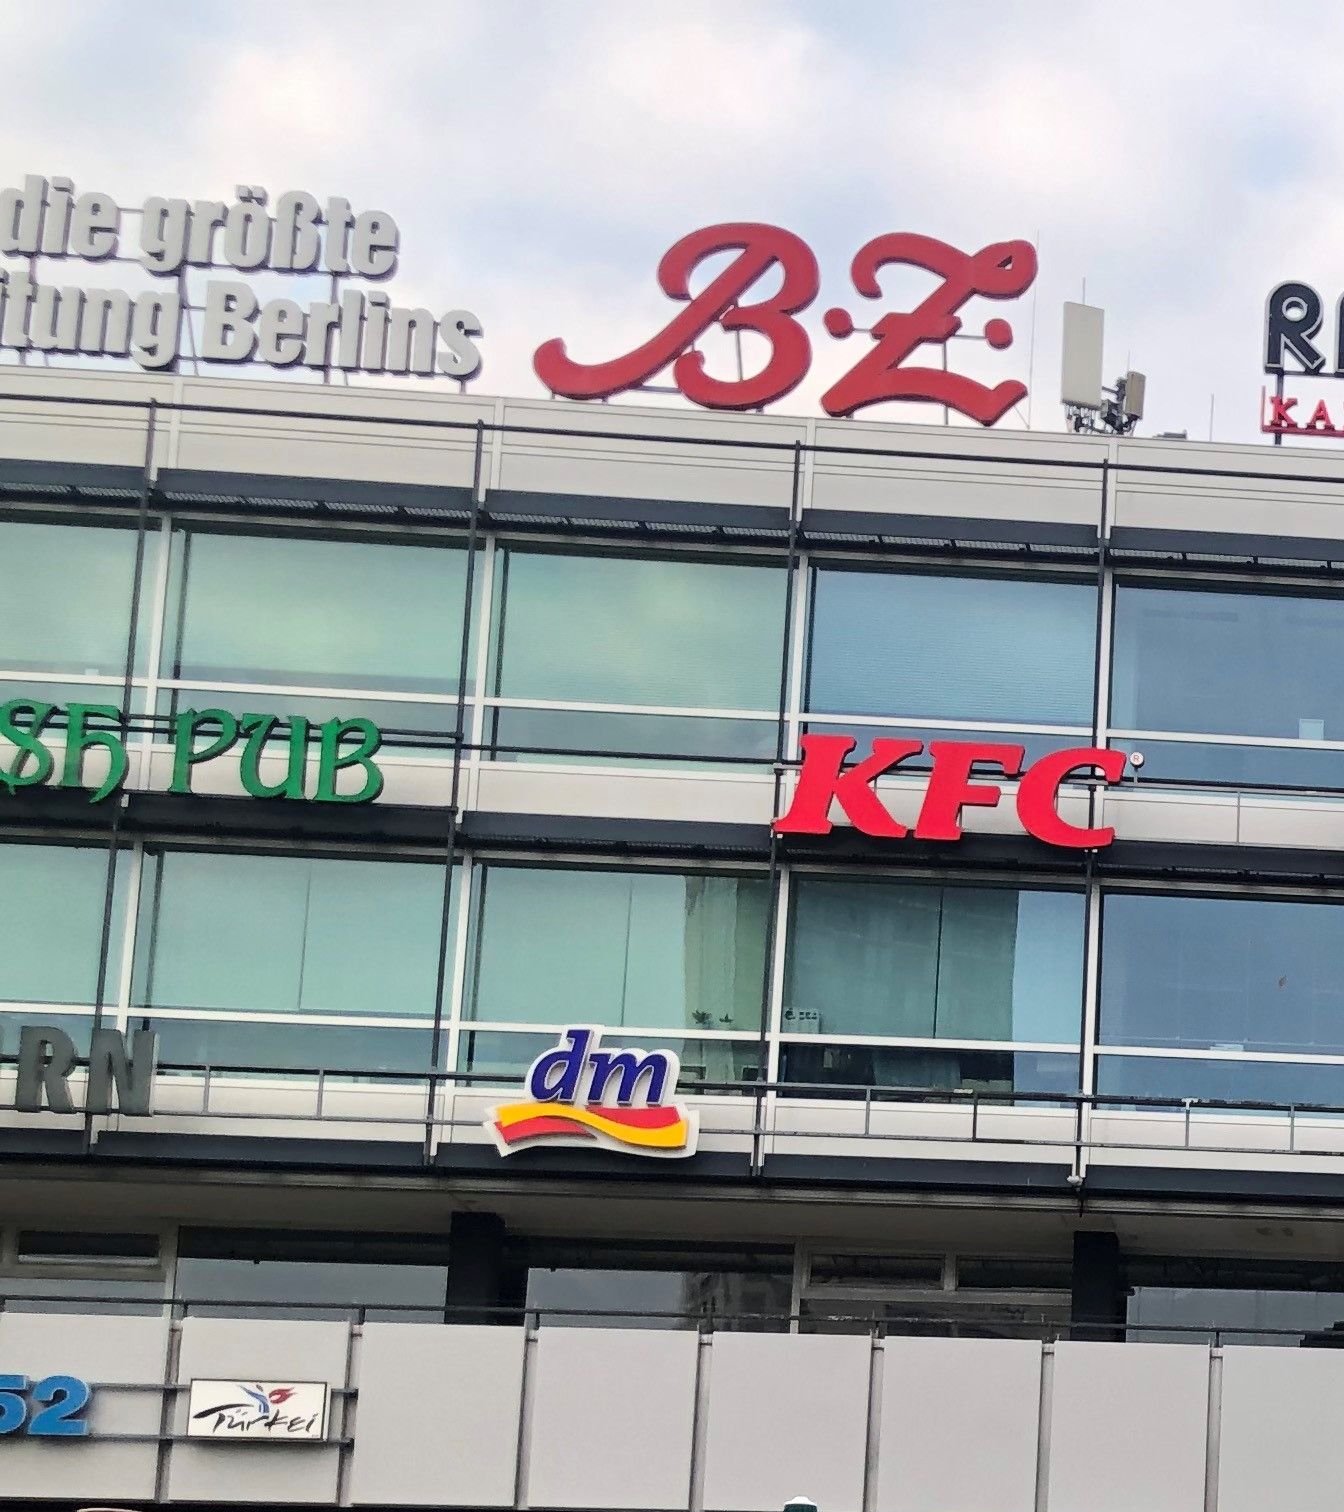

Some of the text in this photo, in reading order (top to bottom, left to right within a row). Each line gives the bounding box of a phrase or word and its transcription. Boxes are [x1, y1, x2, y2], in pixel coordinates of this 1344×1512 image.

[0, 174, 400, 280] die größte
[201, 280, 484, 380] Berlins
[169, 707, 384, 804] PUB
[773, 733, 1128, 849] KFC
[530, 1028, 669, 1104] dm
